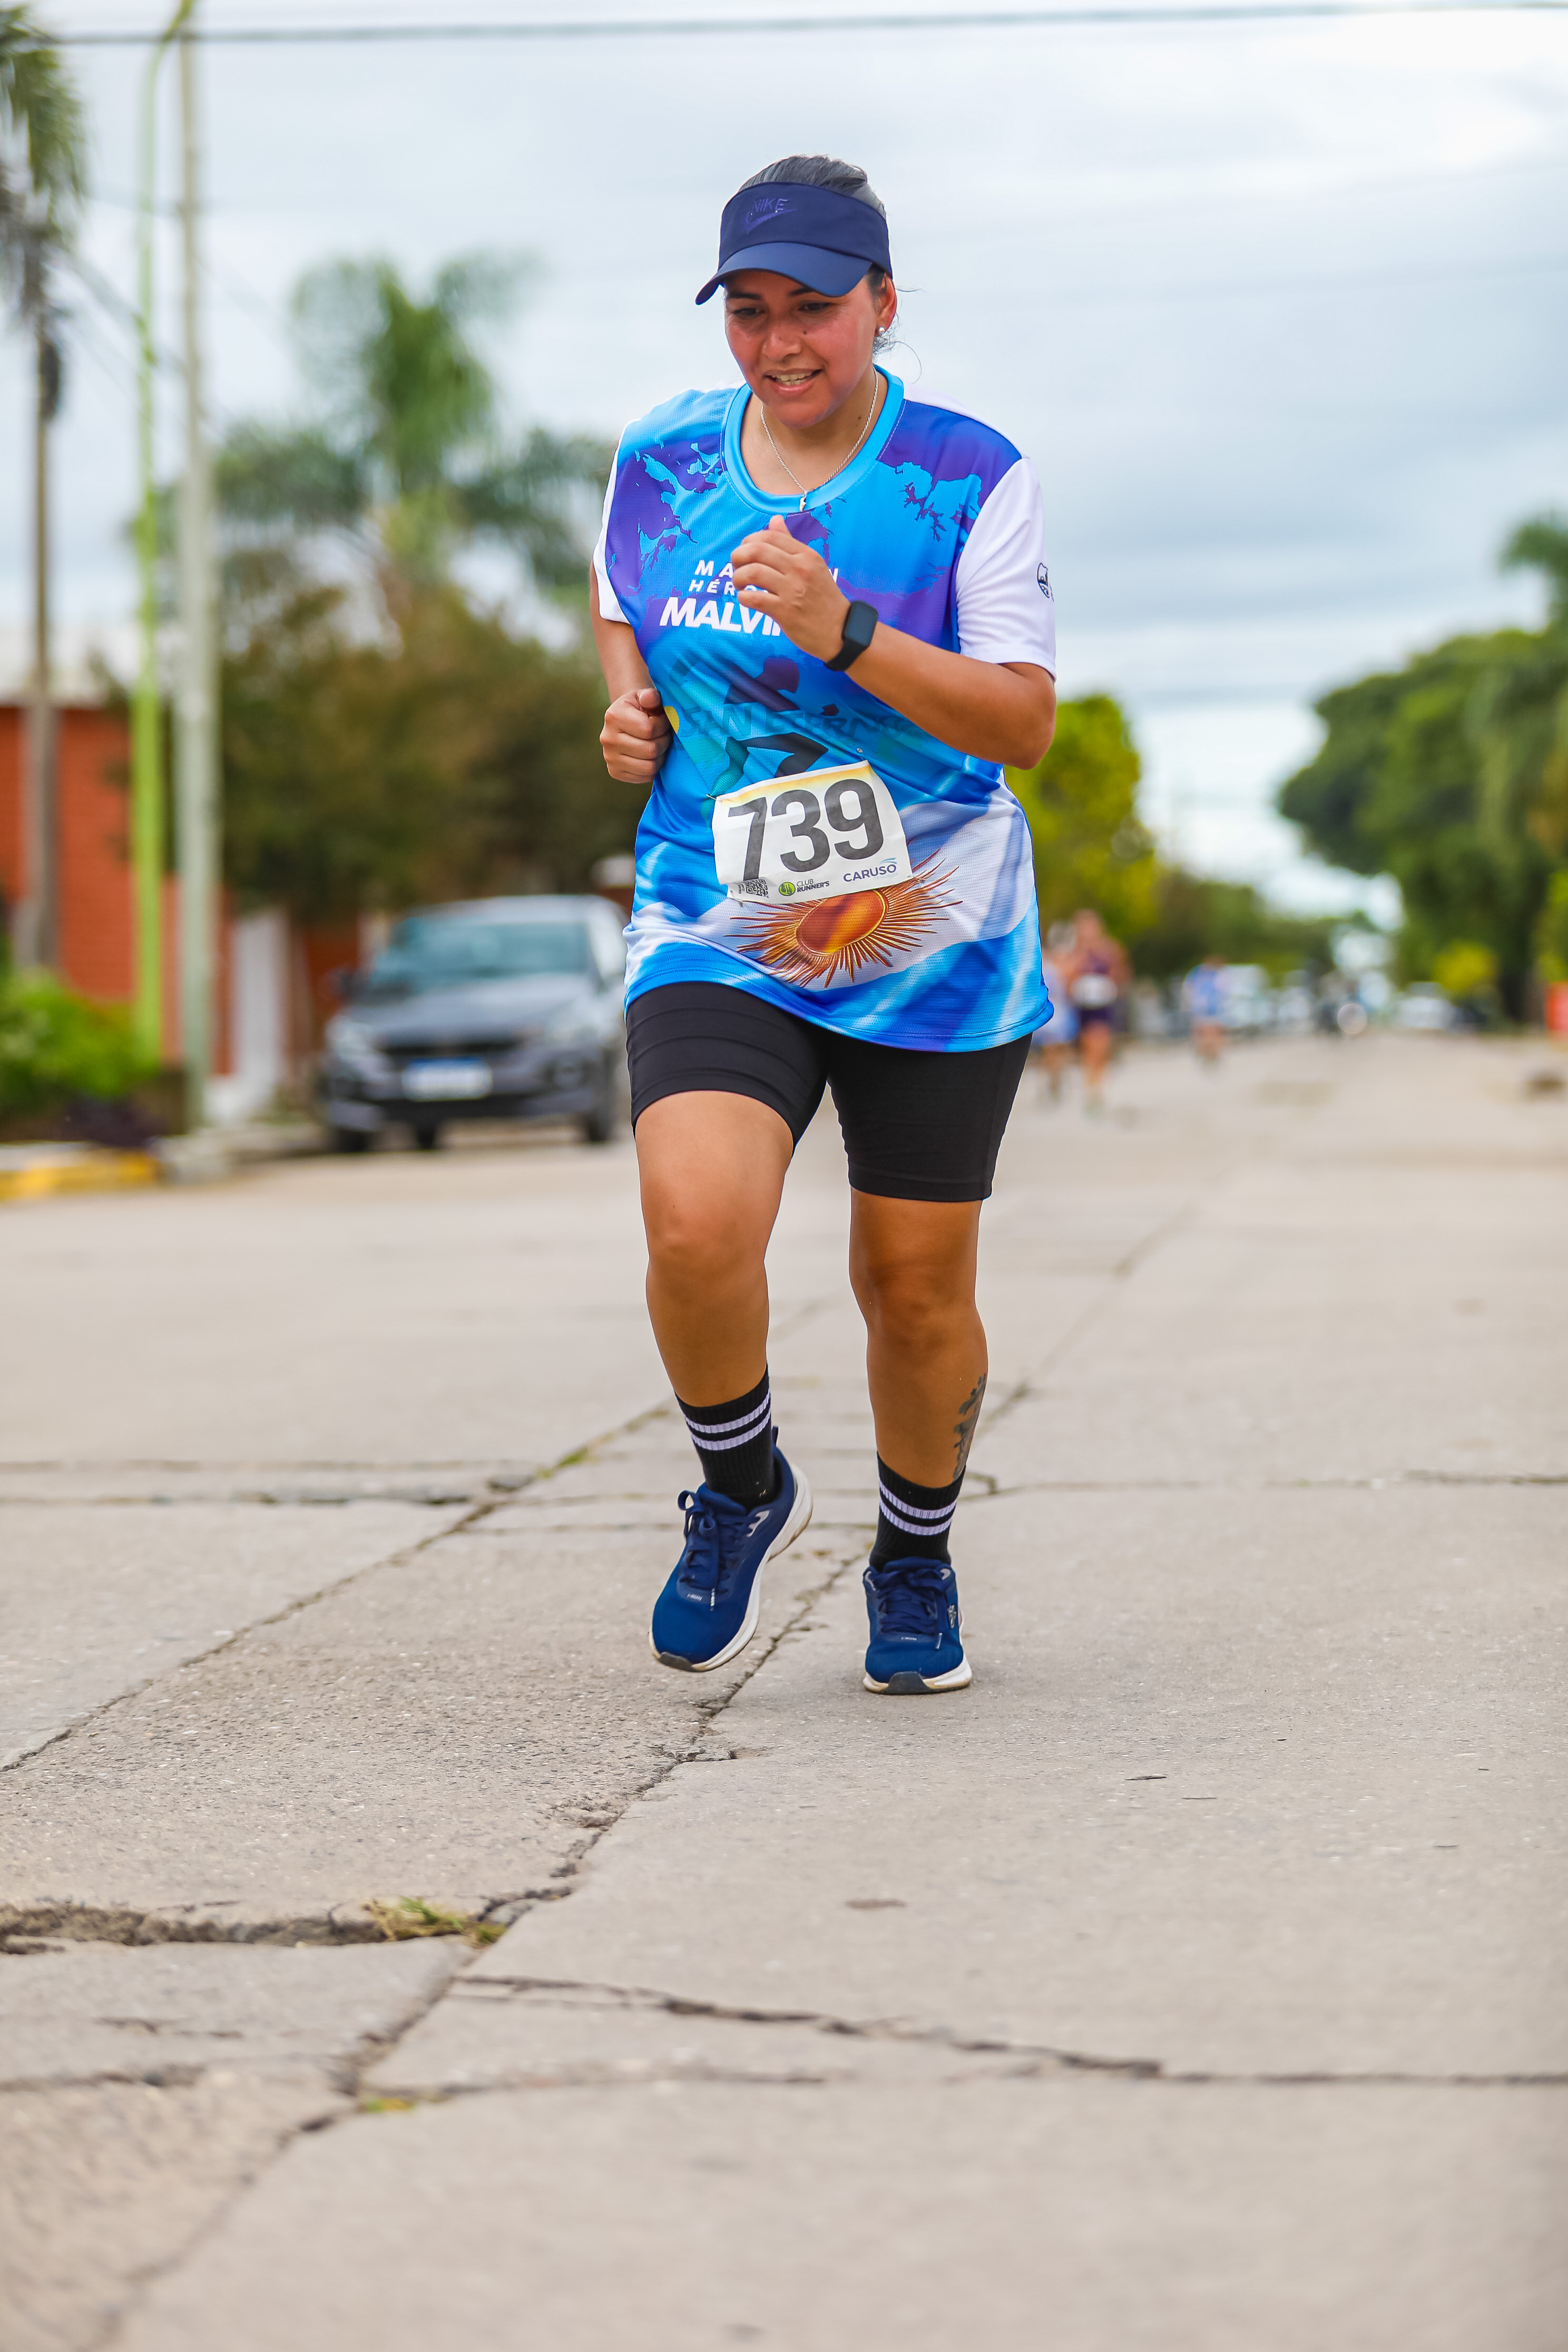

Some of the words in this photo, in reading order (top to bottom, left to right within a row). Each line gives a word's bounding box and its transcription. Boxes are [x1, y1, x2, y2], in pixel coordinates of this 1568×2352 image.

[752, 198, 789, 213] NIKE
[659, 596, 781, 637] MALVI
[728, 778, 884, 881] 739
[843, 864, 897, 882] CARUSO
[796, 878, 814, 887] CLUB
[797, 880, 830, 893] RUNNER'S
